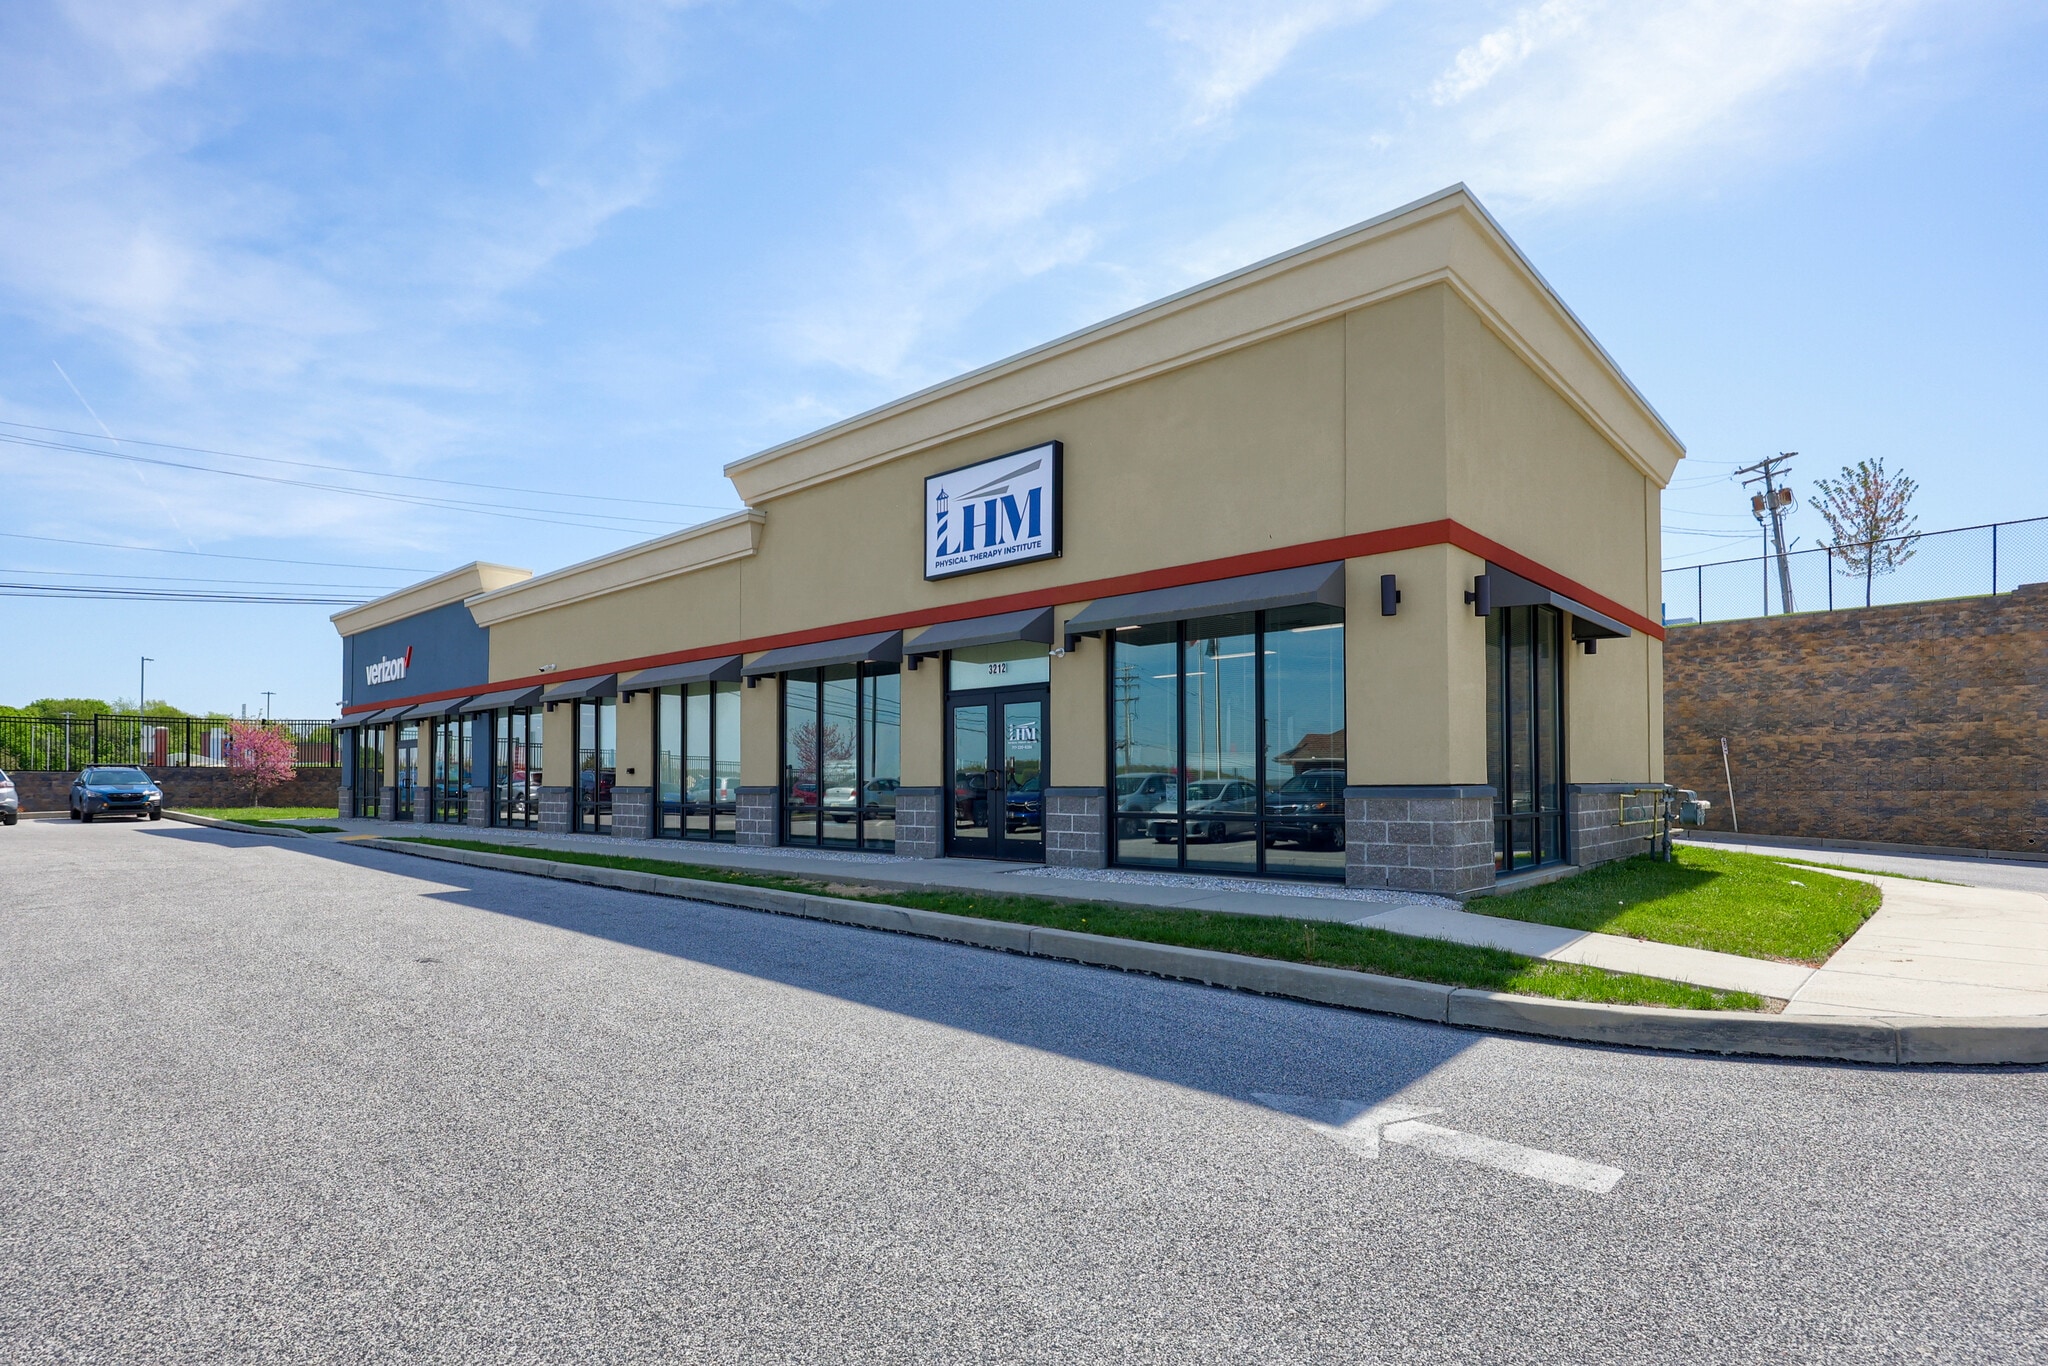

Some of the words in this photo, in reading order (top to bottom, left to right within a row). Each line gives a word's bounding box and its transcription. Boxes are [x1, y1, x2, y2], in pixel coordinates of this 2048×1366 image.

[936, 485, 1042, 557] LHM
[935, 556, 968, 568] PHYSICAL
[969, 548, 1002, 561] THERAPY
[1004, 540, 1042, 554] INSTITUTE
[366, 656, 405, 685] verizon
[988, 663, 1006, 674] 3212
